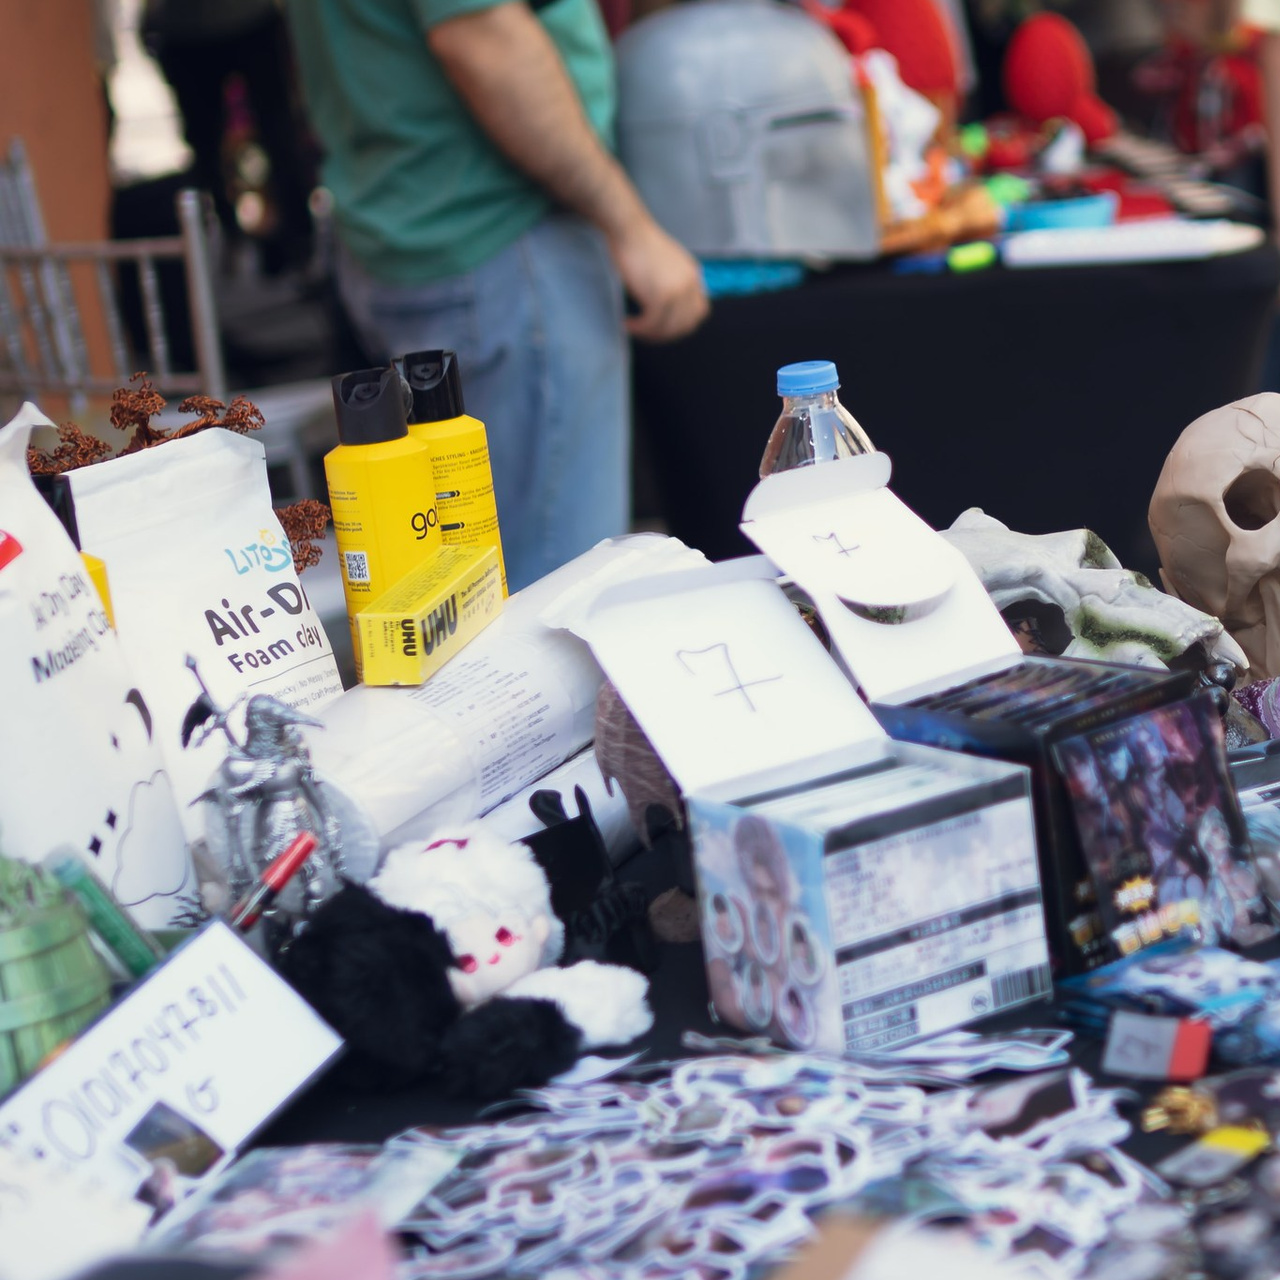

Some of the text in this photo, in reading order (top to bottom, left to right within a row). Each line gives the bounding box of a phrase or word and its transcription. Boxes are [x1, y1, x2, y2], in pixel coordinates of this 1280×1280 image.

[227, 623, 323, 673] Foam clay
[401, 618, 418, 657] UHU
[421, 593, 458, 656] UHU
